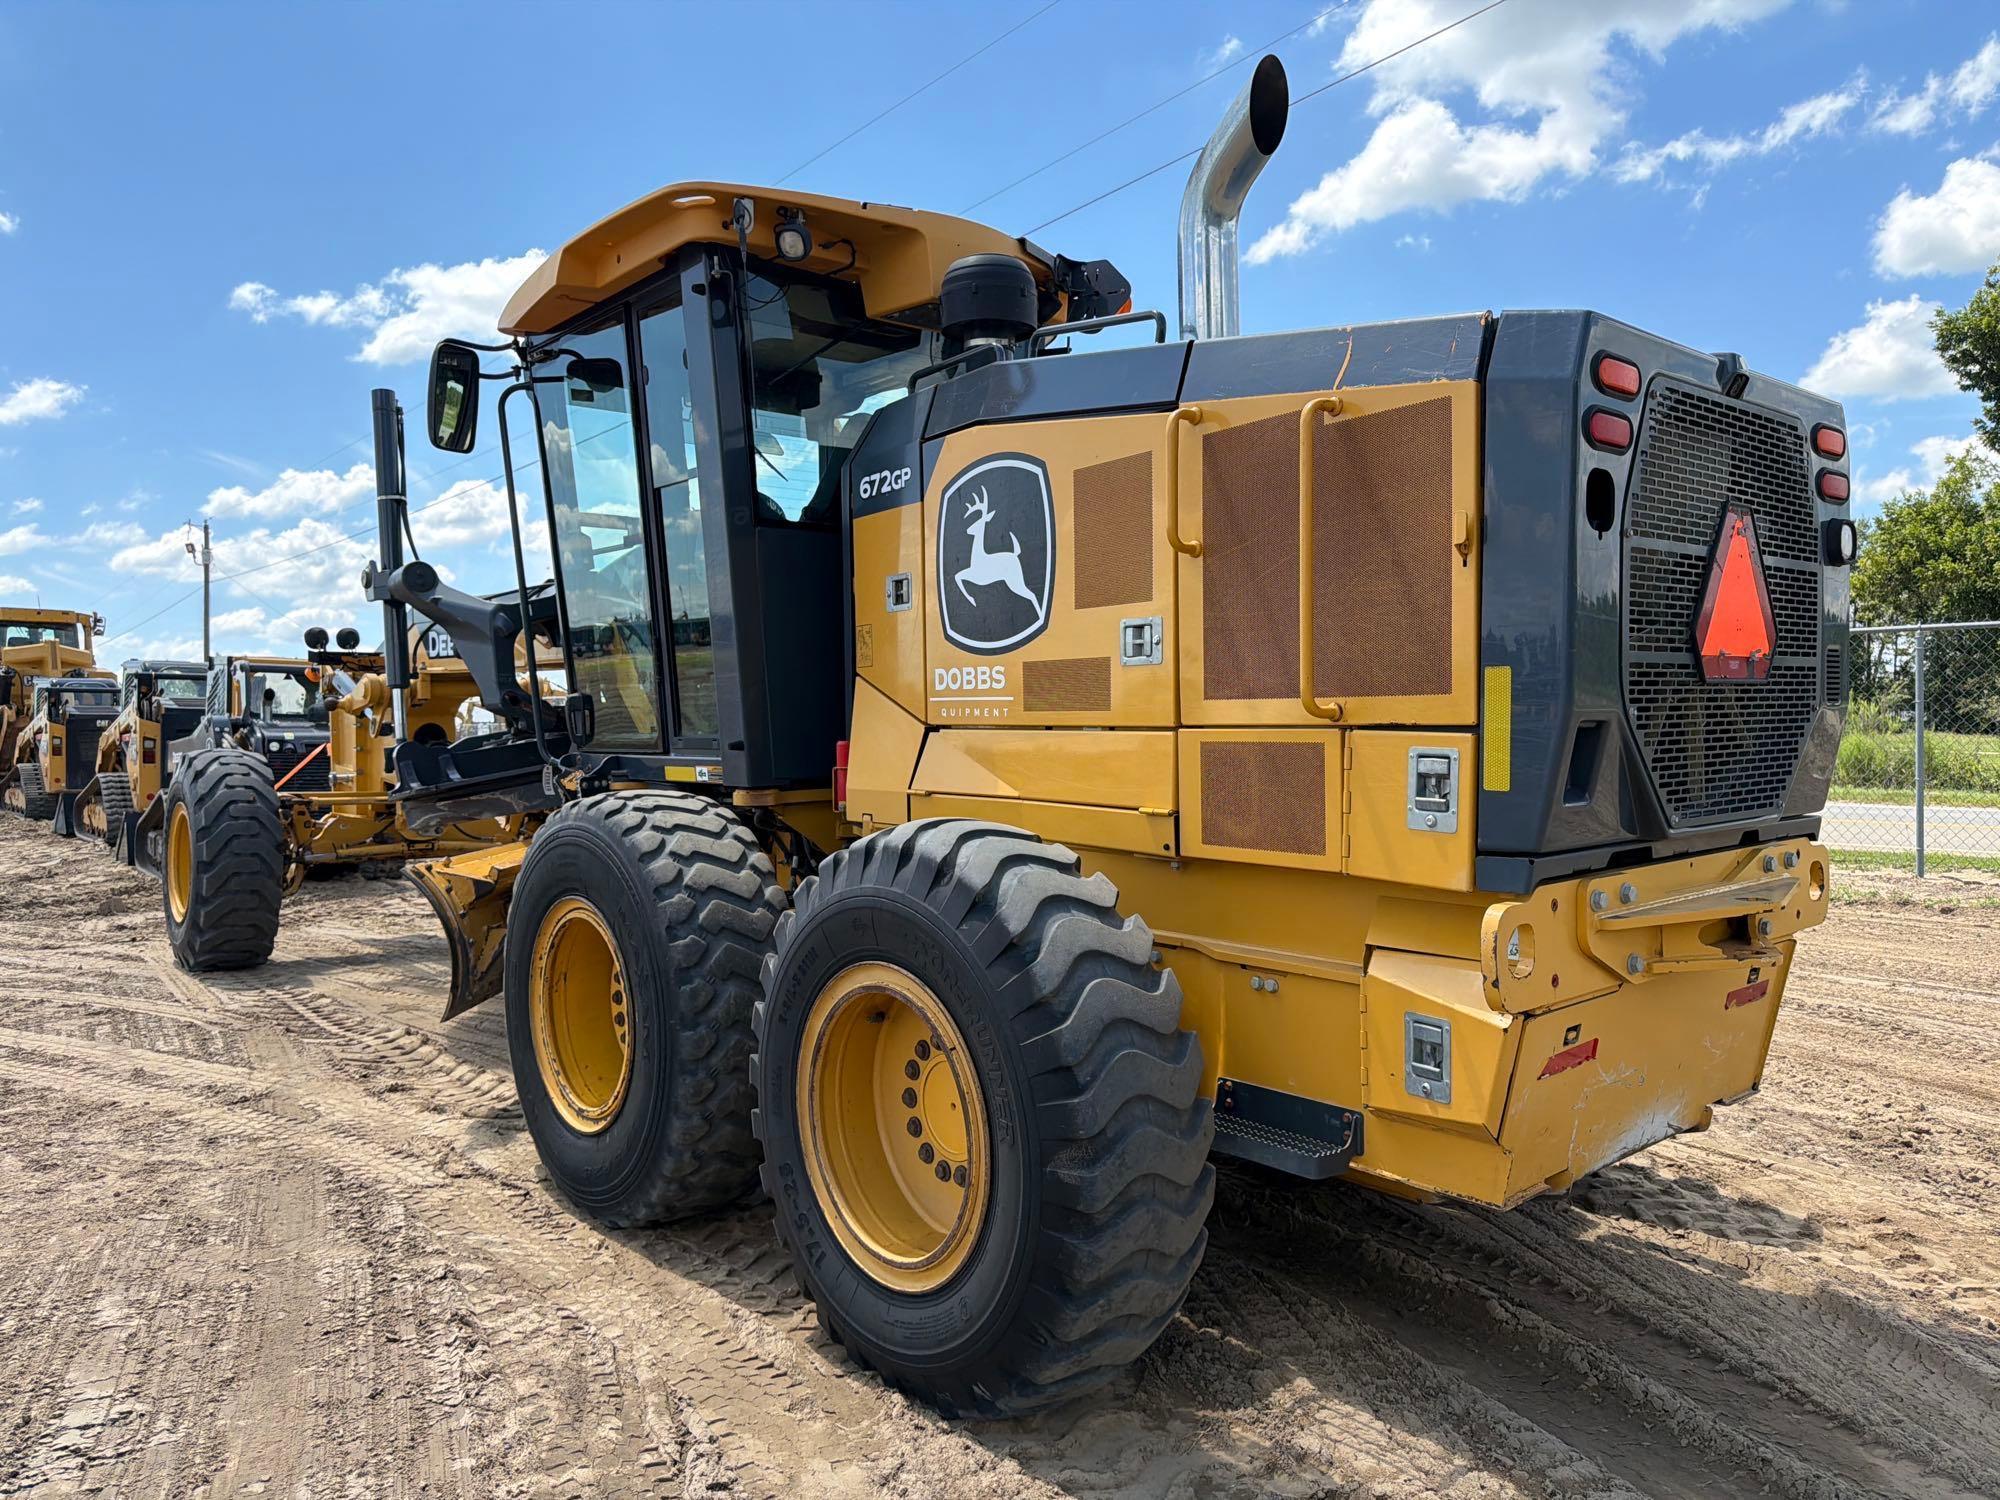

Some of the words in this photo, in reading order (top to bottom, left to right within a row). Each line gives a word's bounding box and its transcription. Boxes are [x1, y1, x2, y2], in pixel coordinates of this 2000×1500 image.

[859, 467, 911, 499] 672GP
[934, 665, 1006, 690] DOBBS
[941, 707, 1009, 717] QUIPMENT
